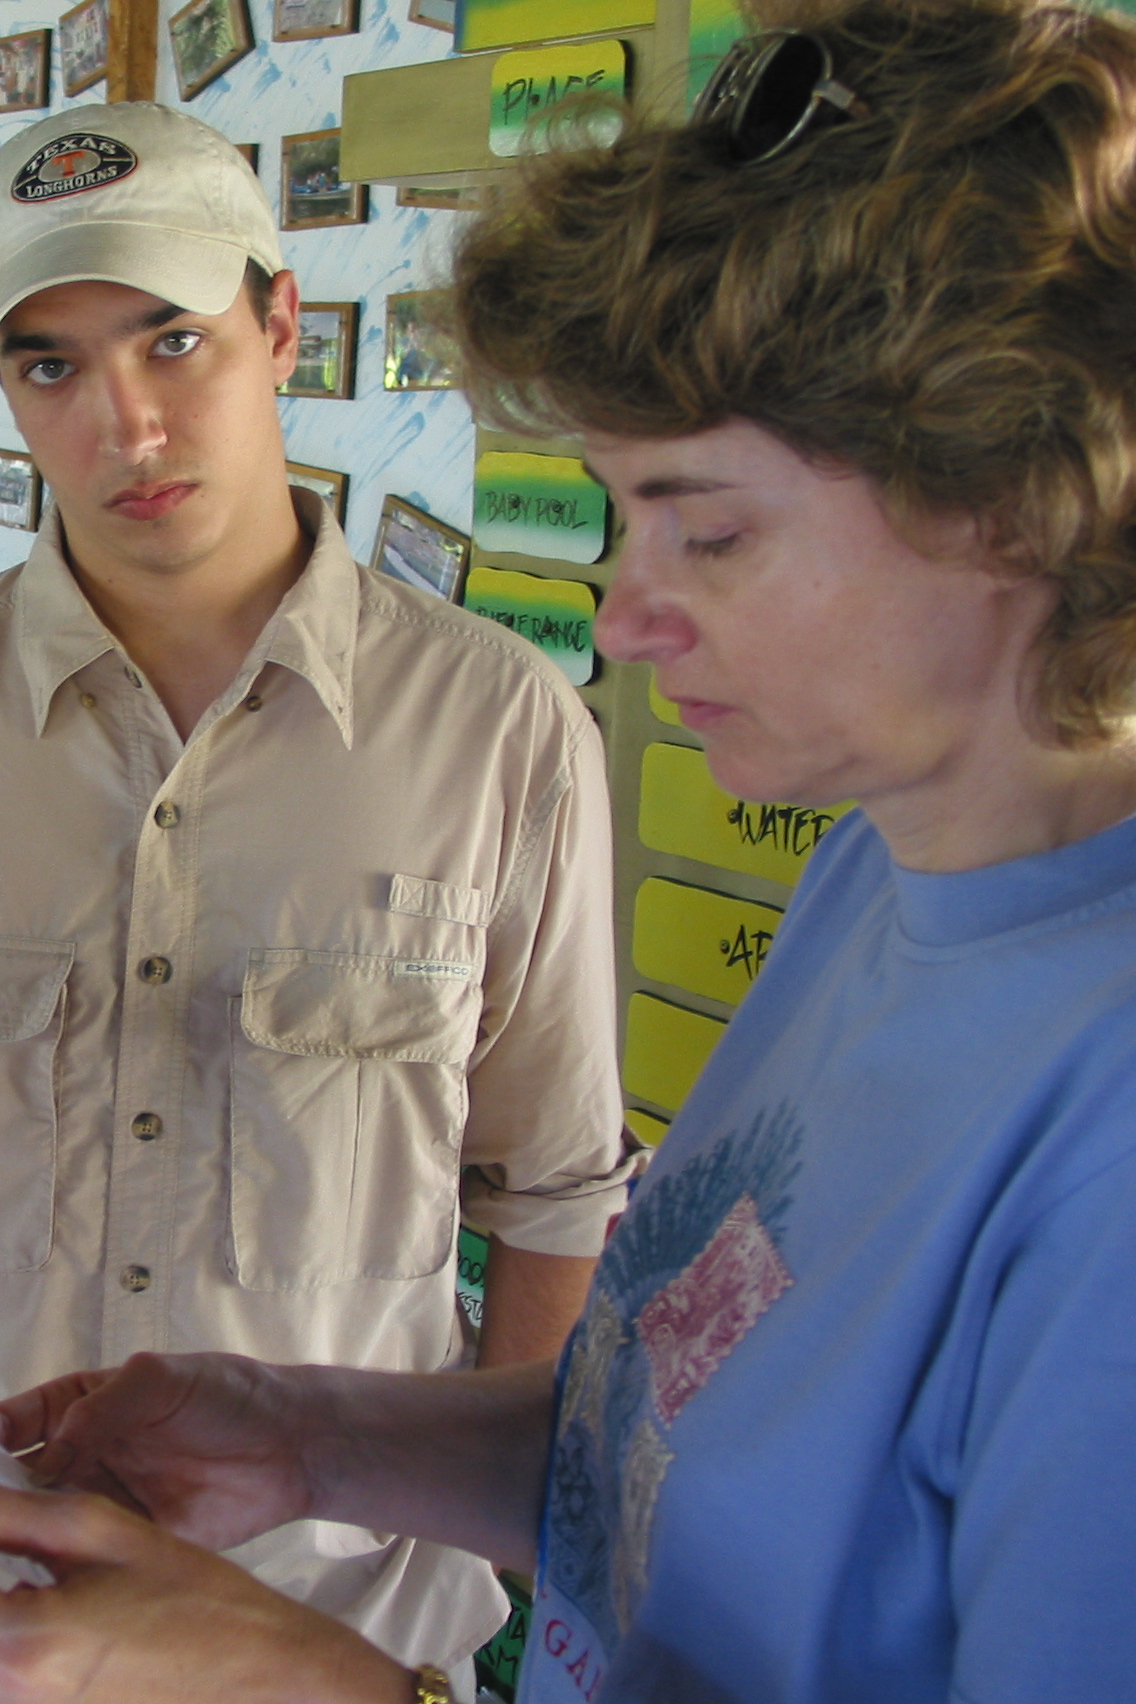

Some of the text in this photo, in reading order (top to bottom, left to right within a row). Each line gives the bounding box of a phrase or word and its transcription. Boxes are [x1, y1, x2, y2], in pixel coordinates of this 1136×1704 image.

[26, 137, 117, 174] TEXAS
[52, 150, 85, 178] T
[26, 165, 119, 198] LONGHORNS
[484, 491, 589, 530] BABY POOL
